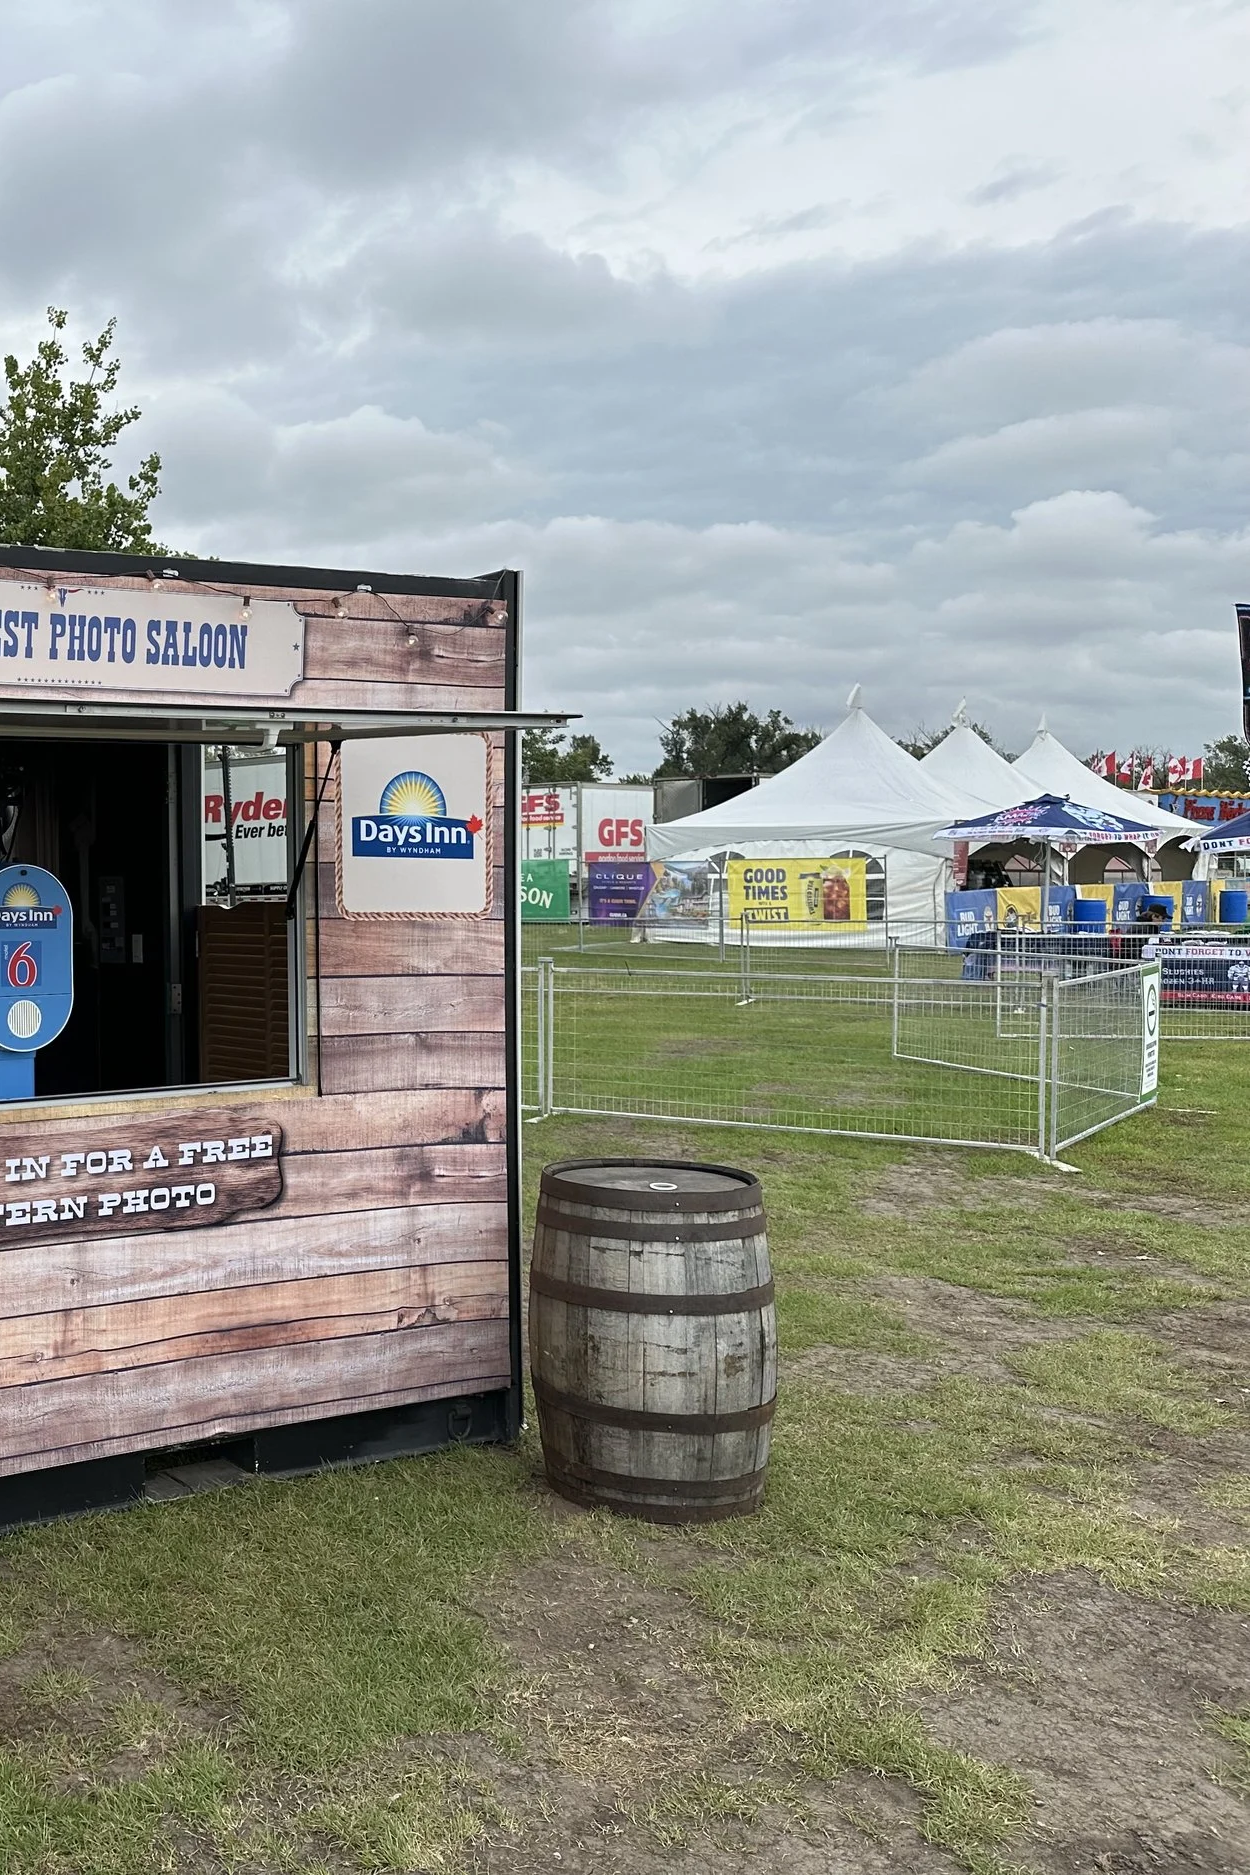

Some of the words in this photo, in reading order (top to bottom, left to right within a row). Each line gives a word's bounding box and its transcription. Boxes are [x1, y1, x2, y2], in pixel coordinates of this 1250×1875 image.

[49, 613, 136, 664] PHOTO
[146, 619, 248, 669] SALOON
[235, 824, 265, 839] Ever
[267, 822, 287, 838] be
[359, 819, 422, 846] Days
[426, 822, 467, 844] Inn
[598, 818, 643, 847] GFS
[1203, 840, 1234, 850] DONT
[743, 868, 787, 883] GOOD
[743, 885, 788, 900] TIMES
[1048, 904, 1061, 916] BUD
[1118, 900, 1129, 911] BUD
[30, 909, 53, 922] Inn
[746, 908, 787, 921] TWIST
[960, 911, 976, 922] BUD
[957, 924, 979, 937] LIGHT
[1186, 948, 1225, 956] FORGET
[7, 941, 38, 988] 6
[5, 1156, 51, 1182] IN
[60, 1149, 133, 1177] FOR
[142, 1145, 169, 1169] A
[178, 1134, 273, 1165] FREE
[98, 1182, 216, 1217] PHOTO
